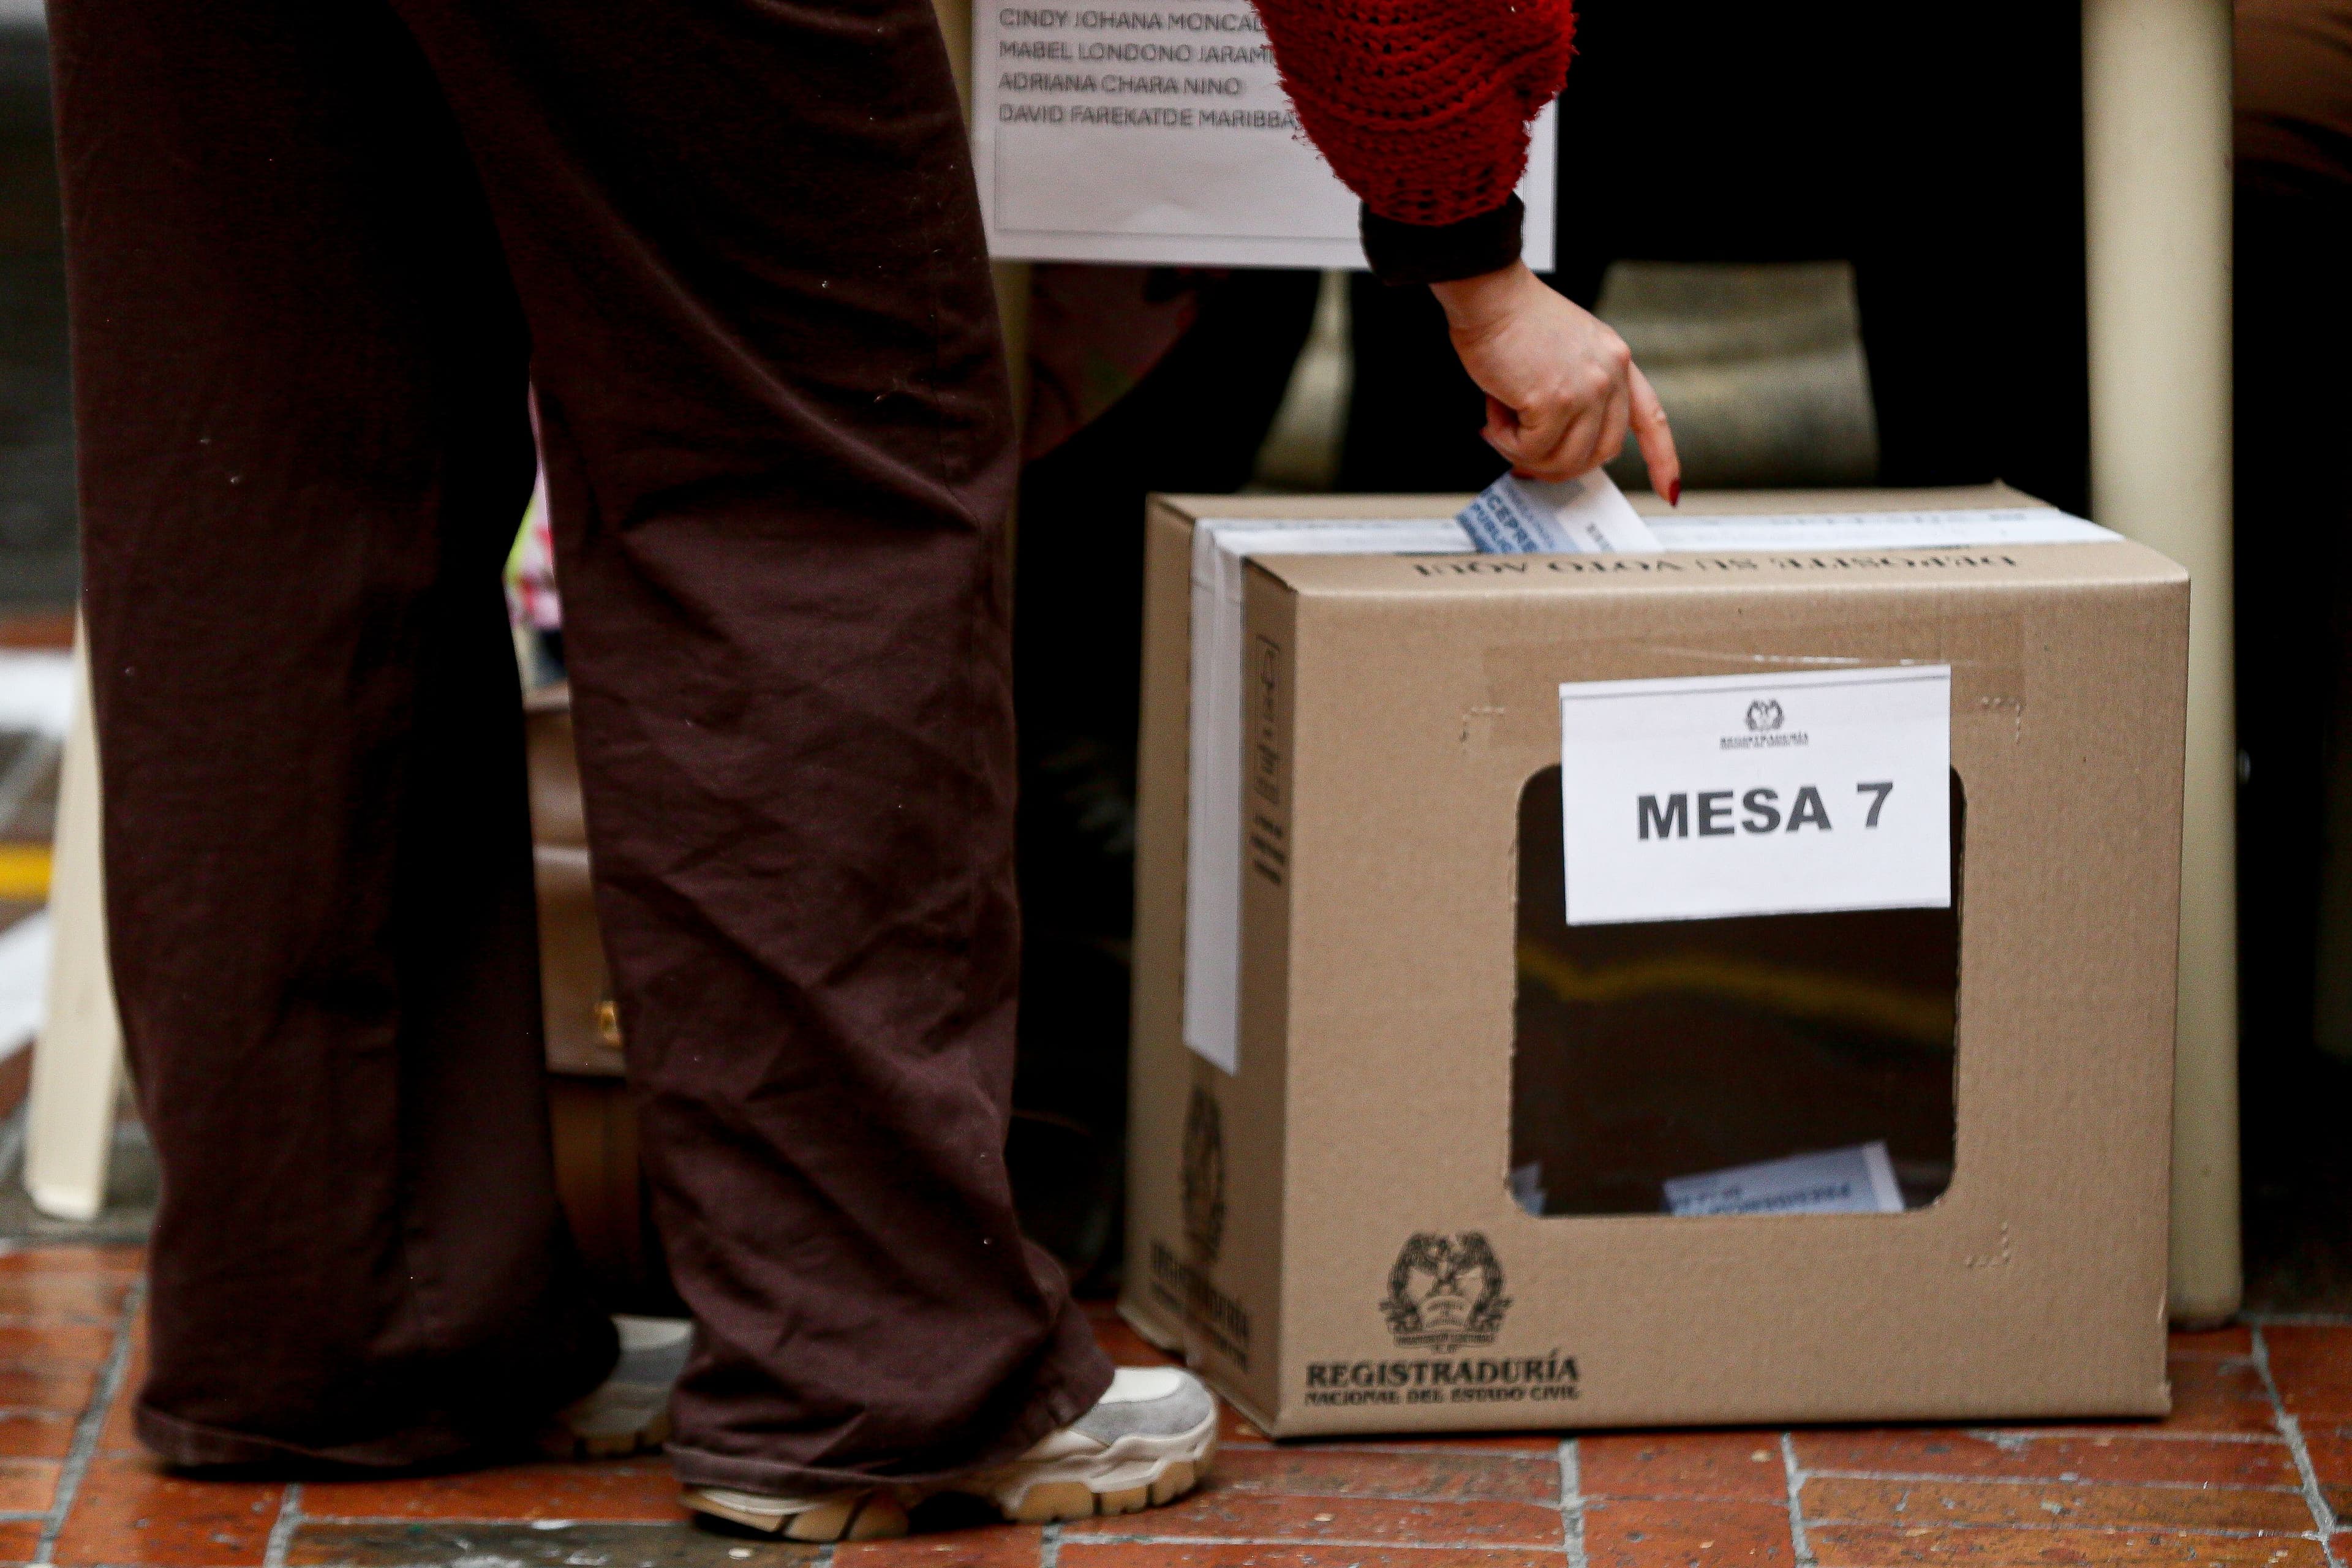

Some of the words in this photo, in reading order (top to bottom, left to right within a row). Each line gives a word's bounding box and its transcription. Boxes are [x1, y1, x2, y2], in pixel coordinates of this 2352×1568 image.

[999, 8, 1068, 28] CINDY
[1076, 10, 1162, 30] JOHANA
[999, 40, 1072, 60] MABEL
[998, 72, 1097, 92] ADRIANA
[1102, 74, 1179, 94] CHARA
[999, 103, 1064, 123] DAVID
[1637, 785, 1832, 841] MESA
[1856, 782, 1894, 829] 7
[1305, 1348, 1578, 1388] REGISTRADURÍA
[1305, 1390, 1400, 1406] NACIONAL
[1407, 1387, 1443, 1403] DEL
[1451, 1385, 1525, 1402] ESTADO
[1531, 1385, 1580, 1401] CIVIL
